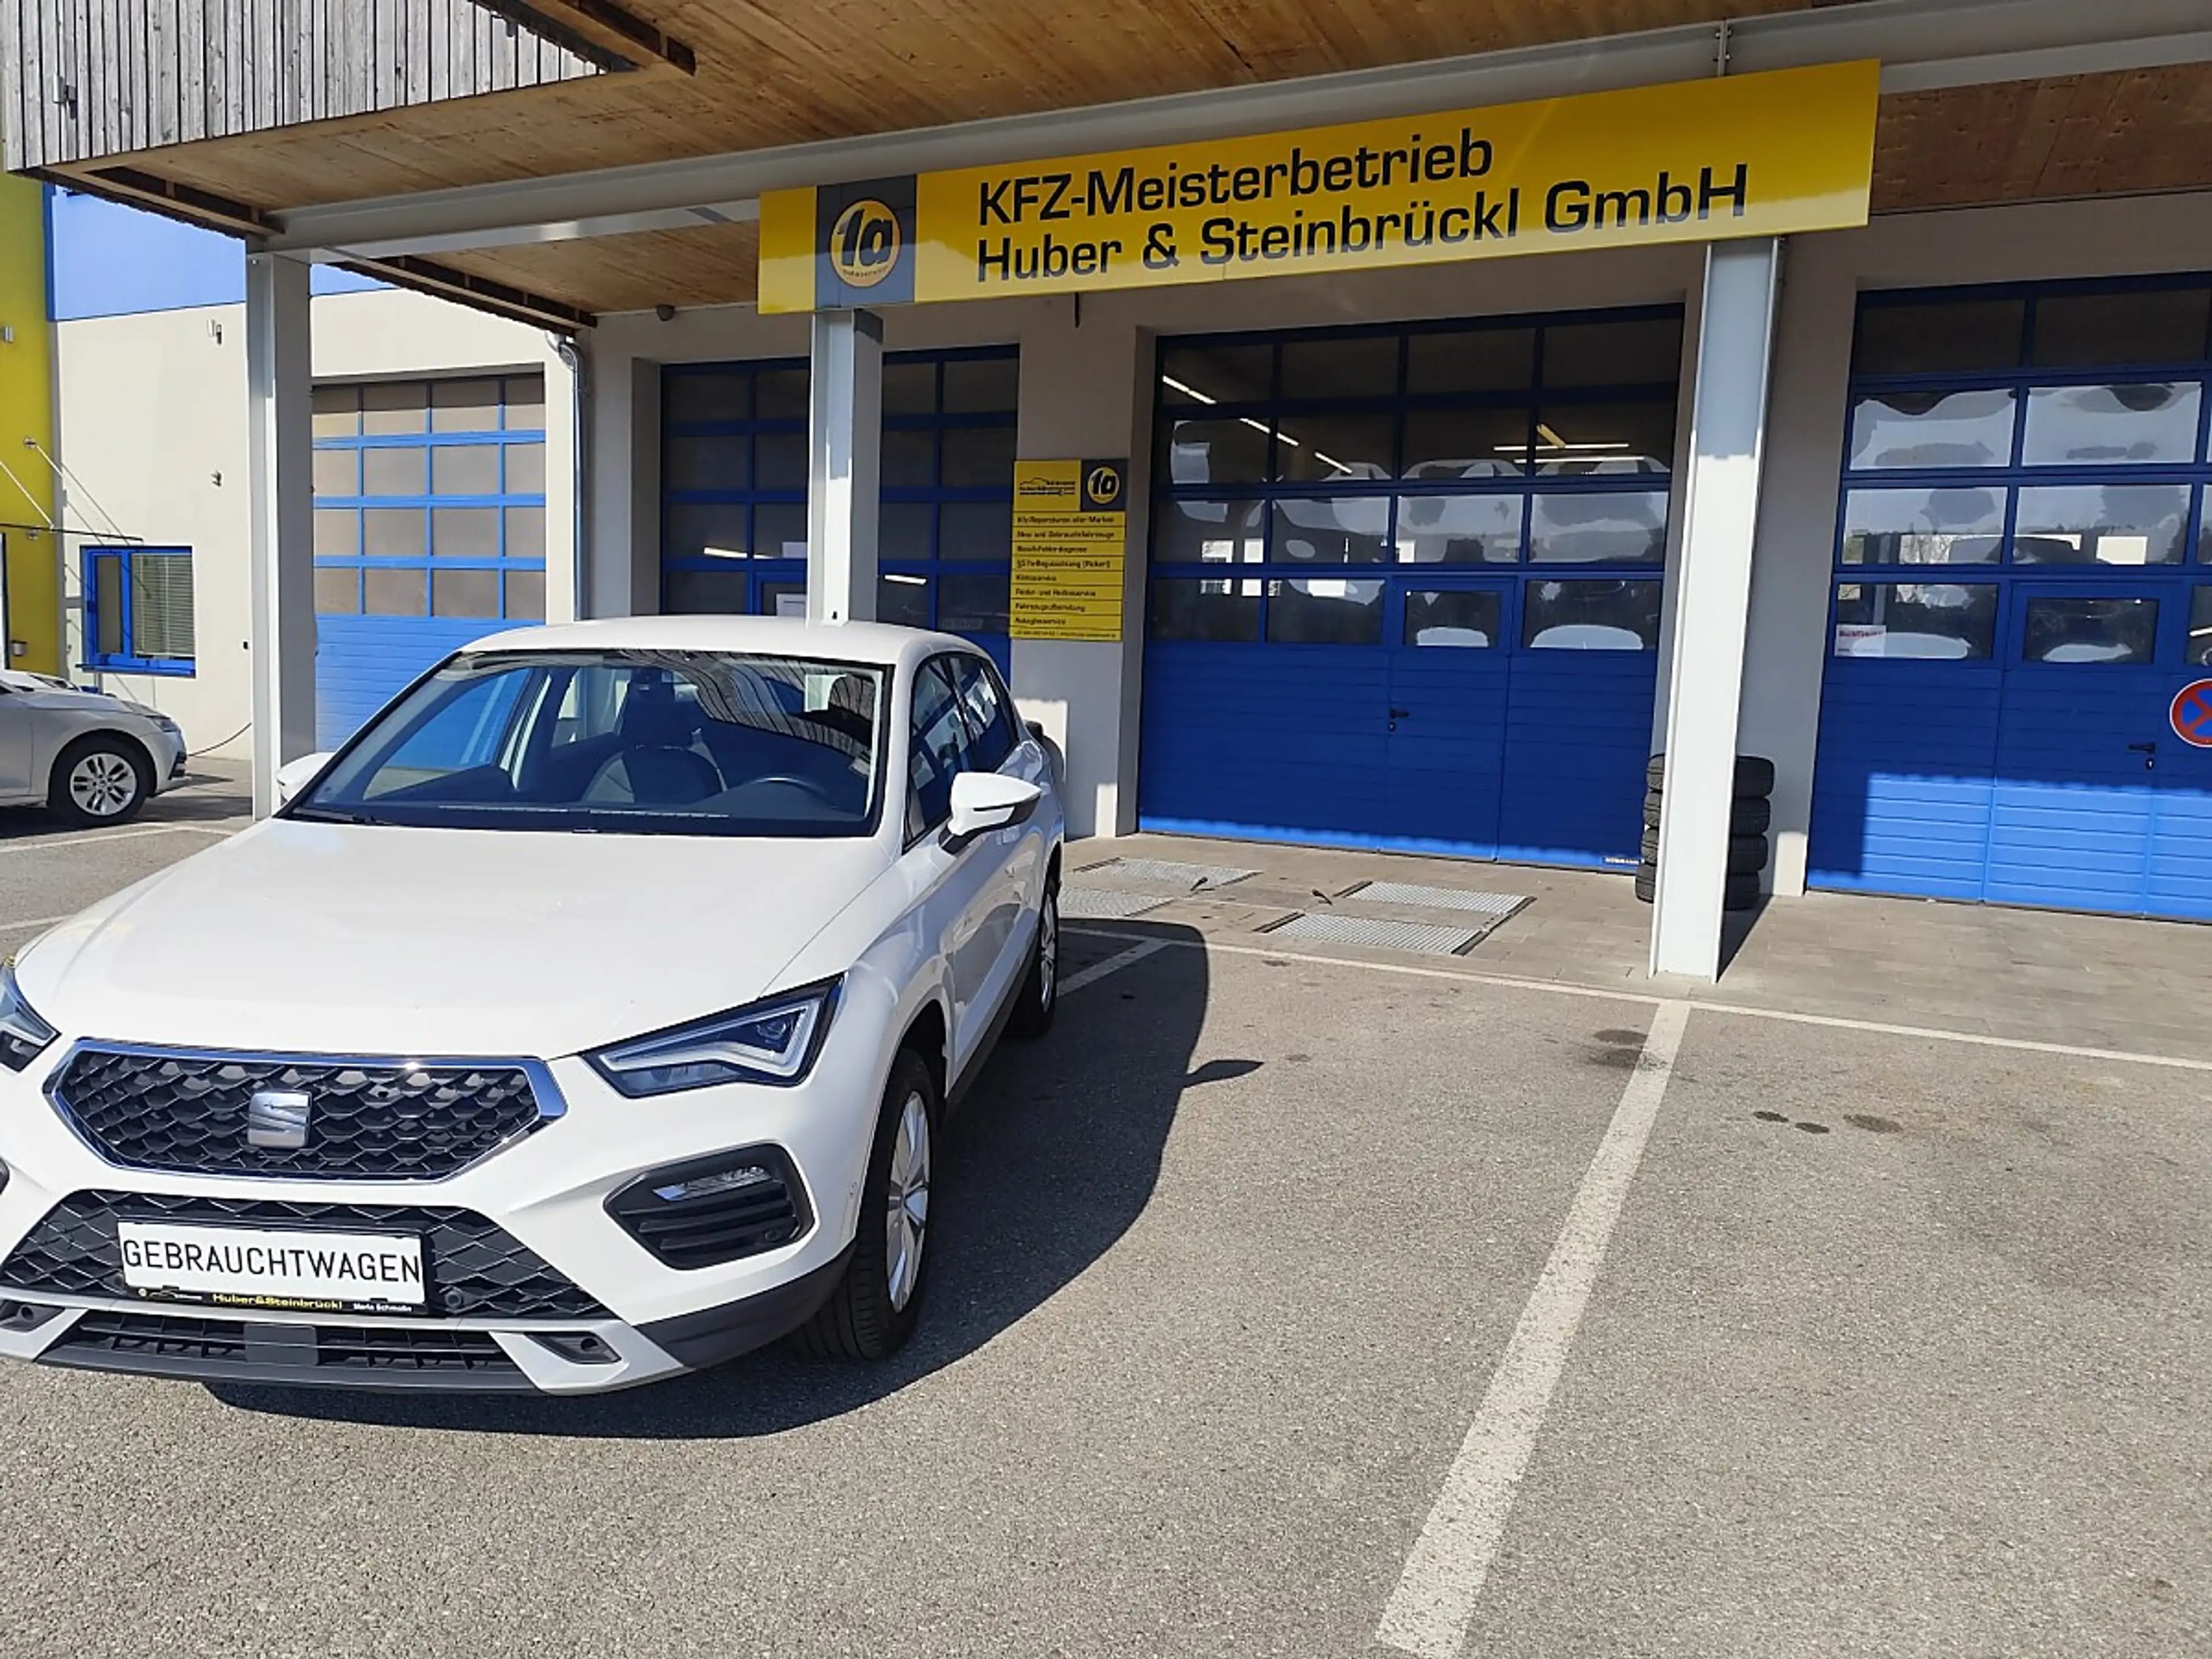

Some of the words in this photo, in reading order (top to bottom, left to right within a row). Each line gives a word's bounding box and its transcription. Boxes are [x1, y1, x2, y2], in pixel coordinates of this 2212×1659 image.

[979, 233, 1122, 282] Huber
[1143, 223, 1180, 270] &
[1200, 187, 1520, 265] Steinbrückl
[1543, 163, 1748, 234] GmbH
[980, 127, 1493, 226] KFZ-Meisterbetrieb
[123, 1240, 420, 1283] GEBRAUCHTWAGEN
